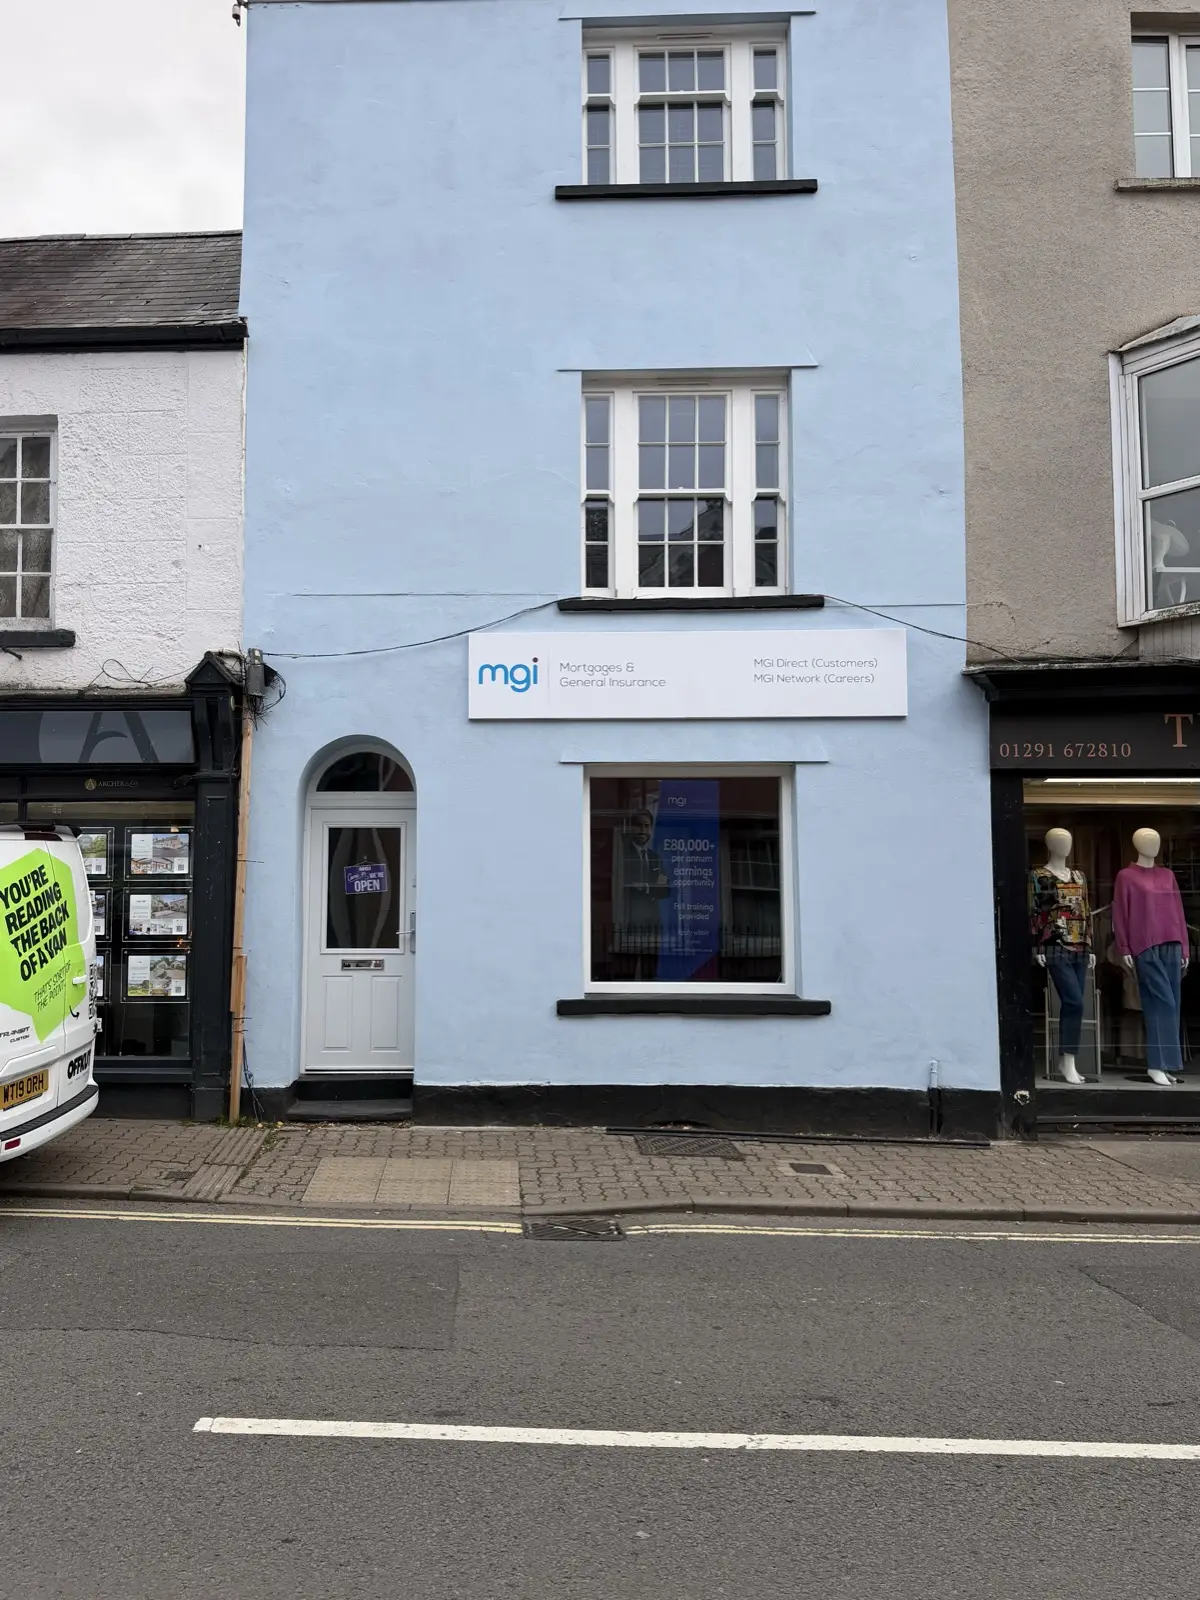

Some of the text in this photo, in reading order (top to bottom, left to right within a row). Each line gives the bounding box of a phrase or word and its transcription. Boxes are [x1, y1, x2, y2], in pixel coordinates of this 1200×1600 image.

[559, 662, 635, 676] Mortgages &
[753, 658, 878, 669] MGI Direct (Customers)
[478, 657, 539, 693] mgi
[559, 677, 666, 687] General Insurance
[753, 673, 875, 684] MGI Network (Careers)
[1000, 743, 1132, 758] 01291 672810
[663, 838, 715, 852] £80,000+
[671, 855, 684, 863] per
[673, 865, 713, 878] earnings
[0, 864, 49, 910] YOU'RE
[354, 879, 380, 892] OPEN
[673, 879, 715, 888] opportunity
[5, 881, 62, 936] READING
[10, 900, 70, 958] THE BACK
[20, 927, 68, 982] OF A VAN
[3, 1080, 25, 1103] WT19
[26, 1072, 44, 1095] ORH
